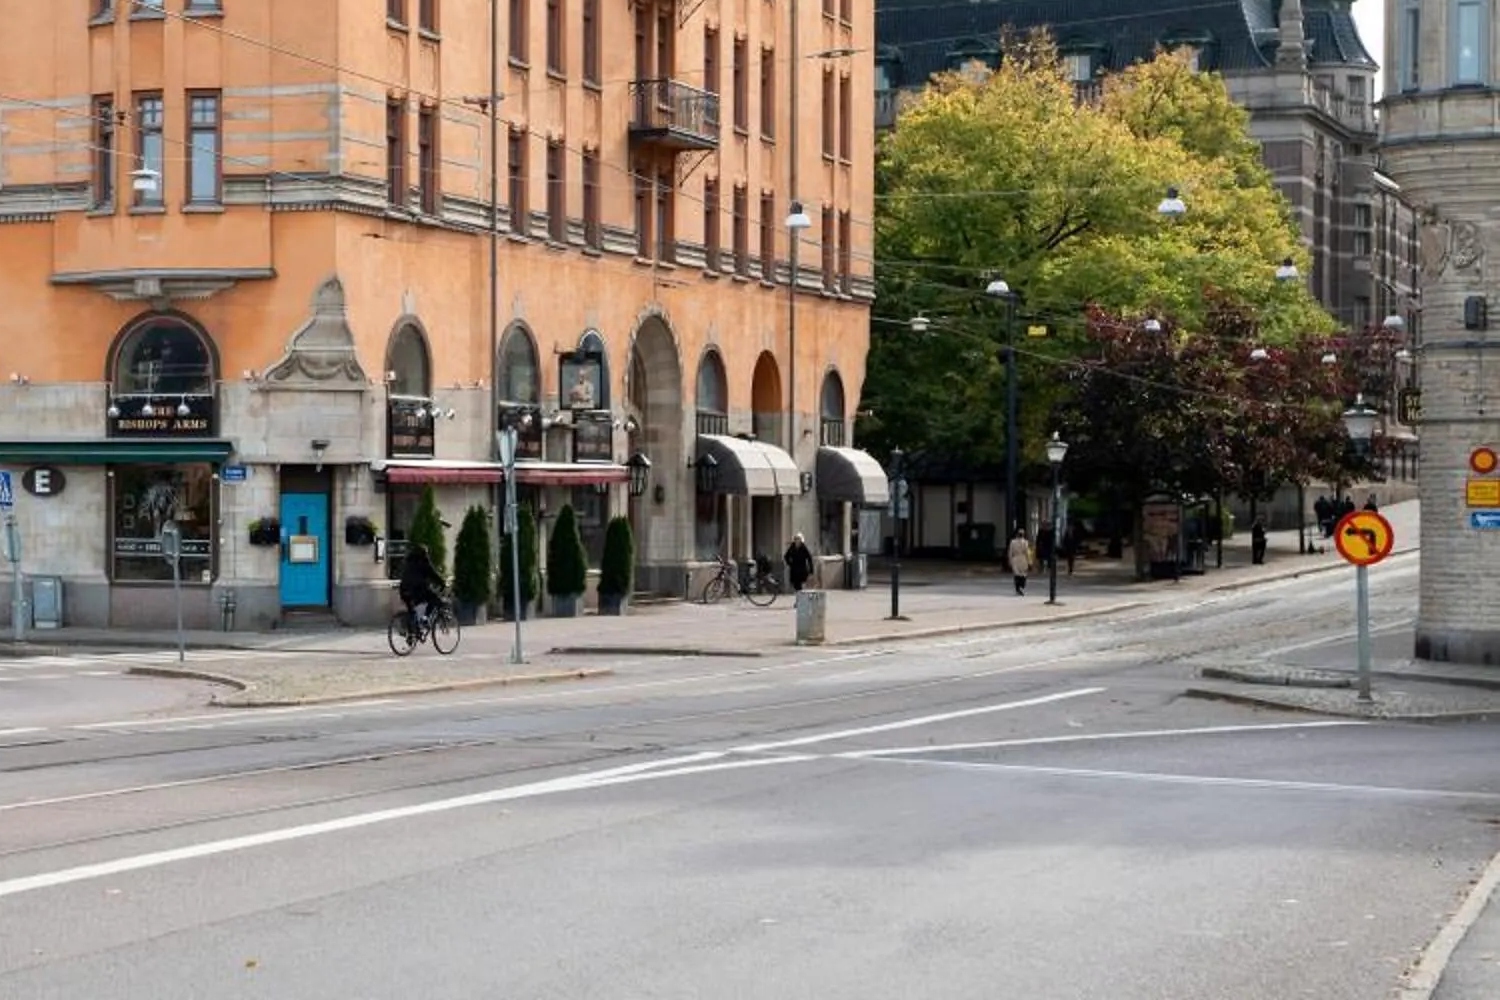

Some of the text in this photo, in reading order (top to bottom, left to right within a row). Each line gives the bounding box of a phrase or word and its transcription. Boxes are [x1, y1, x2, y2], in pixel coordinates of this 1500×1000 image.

[118, 419, 208, 430] BISHOPS ARMS
[35, 470, 52, 493] E
